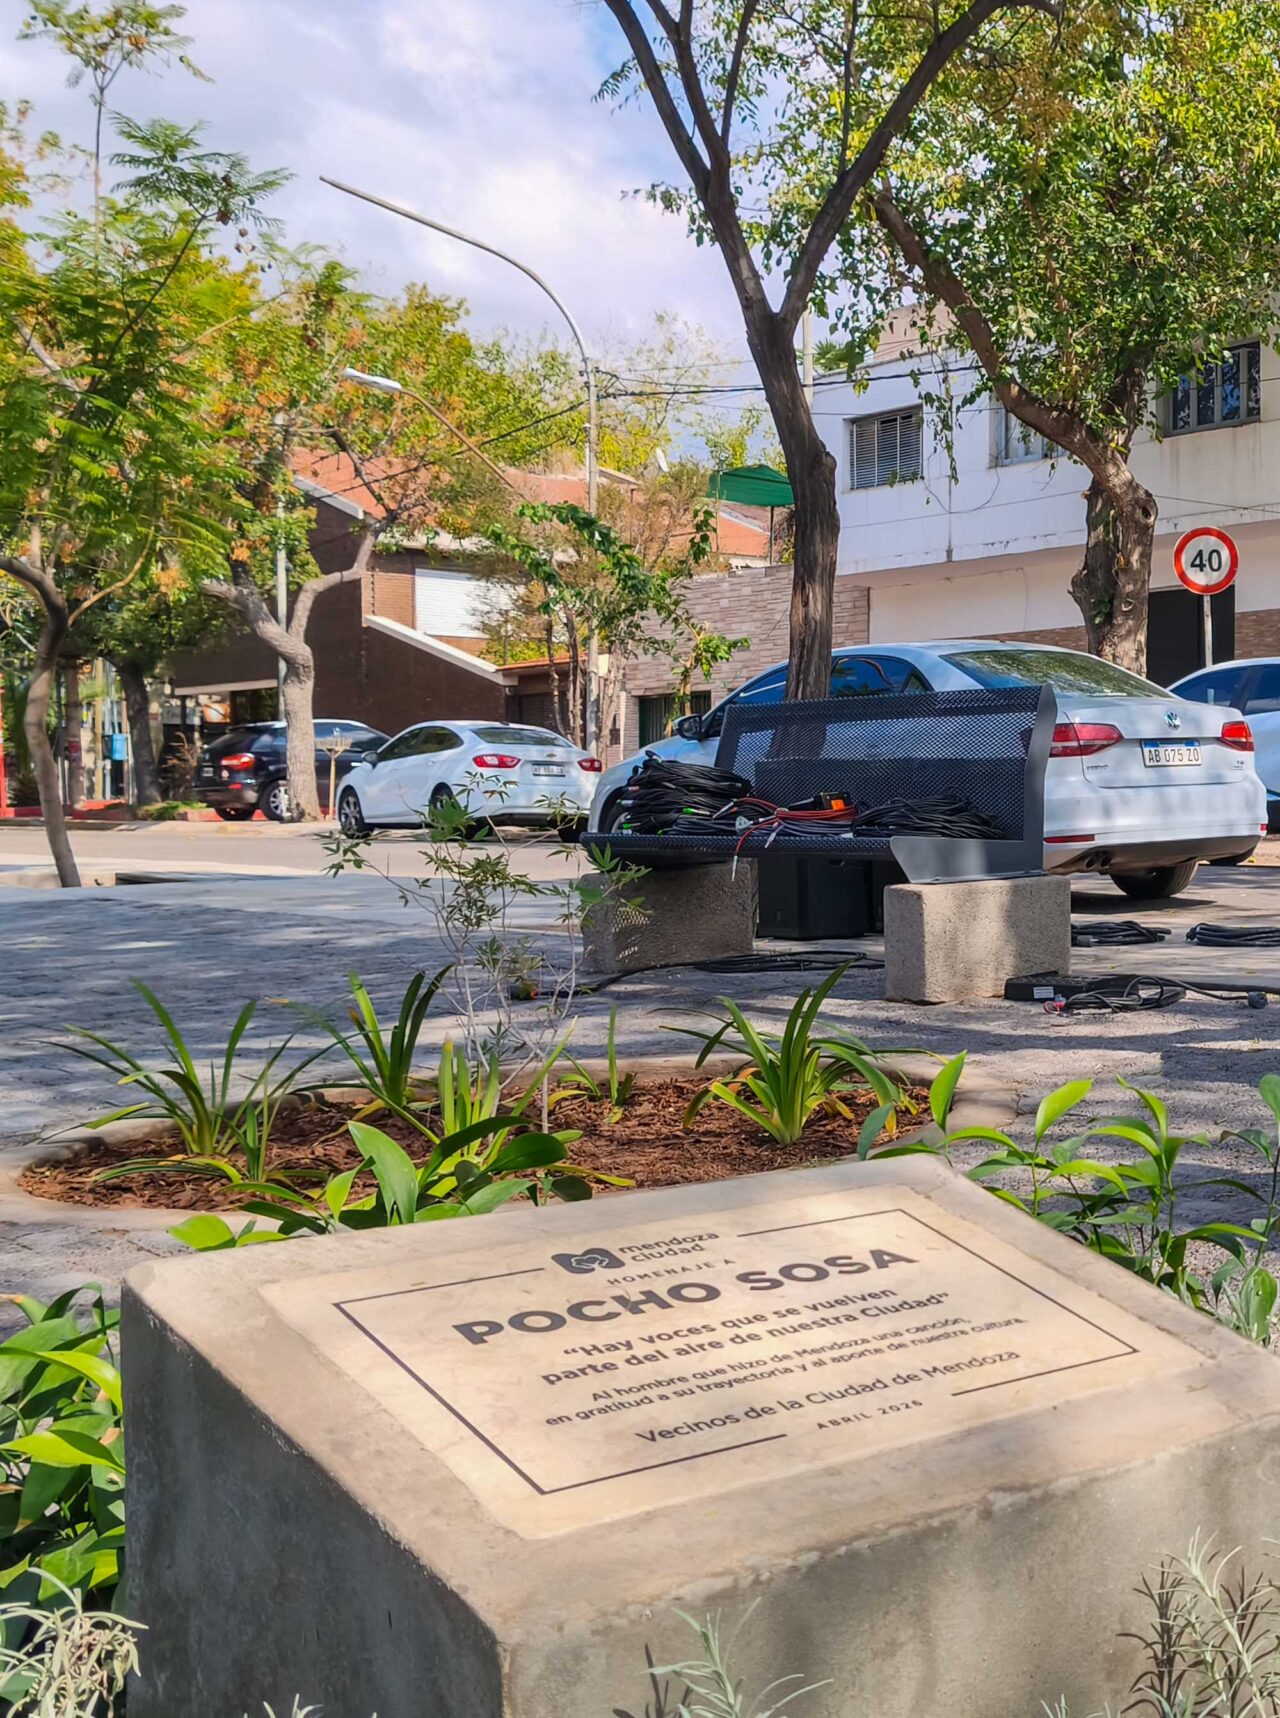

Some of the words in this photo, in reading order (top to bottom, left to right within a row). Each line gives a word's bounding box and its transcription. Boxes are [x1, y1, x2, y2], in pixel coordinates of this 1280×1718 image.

[1190, 549, 1222, 572] 40
[1148, 749, 1161, 763] AB
[1164, 749, 1183, 762] 075
[618, 1233, 719, 1254] mendoza
[631, 1243, 705, 1262] ciudad
[607, 1261, 714, 1285] HOMENAJE
[452, 1282, 721, 1345] POCHO
[735, 1249, 920, 1291] SOSA
[639, 1322, 717, 1344] voces
[720, 1312, 769, 1330] que
[773, 1307, 801, 1319] se
[803, 1288, 898, 1313] vuelven
[540, 1361, 620, 1386] parte
[624, 1349, 669, 1367] del
[674, 1340, 724, 1357] aire
[729, 1331, 762, 1345] de
[766, 1312, 860, 1337] nuestra
[591, 1391, 613, 1403] Al
[613, 1376, 690, 1397] hombre
[692, 1366, 728, 1380] que
[727, 1357, 768, 1373] hizo
[771, 1352, 793, 1363] de
[793, 1337, 871, 1360] Mendoza
[871, 1330, 903, 1342] una
[545, 1414, 573, 1426] en
[575, 1396, 654, 1421] gratitud
[672, 1387, 697, 1398] su
[696, 1366, 794, 1393] trayectoria
[795, 1363, 808, 1373] y
[811, 1357, 827, 1368] al
[830, 1348, 886, 1365] aporte
[886, 1341, 910, 1352] de
[911, 1329, 969, 1347] nuestra
[634, 1413, 741, 1443] Vecinos
[743, 1404, 777, 1421] de
[777, 1399, 805, 1412] la
[805, 1377, 889, 1405] Ciudad
[892, 1371, 922, 1385] de
[920, 1349, 1021, 1379] Mendoza
[815, 1411, 873, 1430] ABRIL
[877, 1400, 923, 1415] 2026
